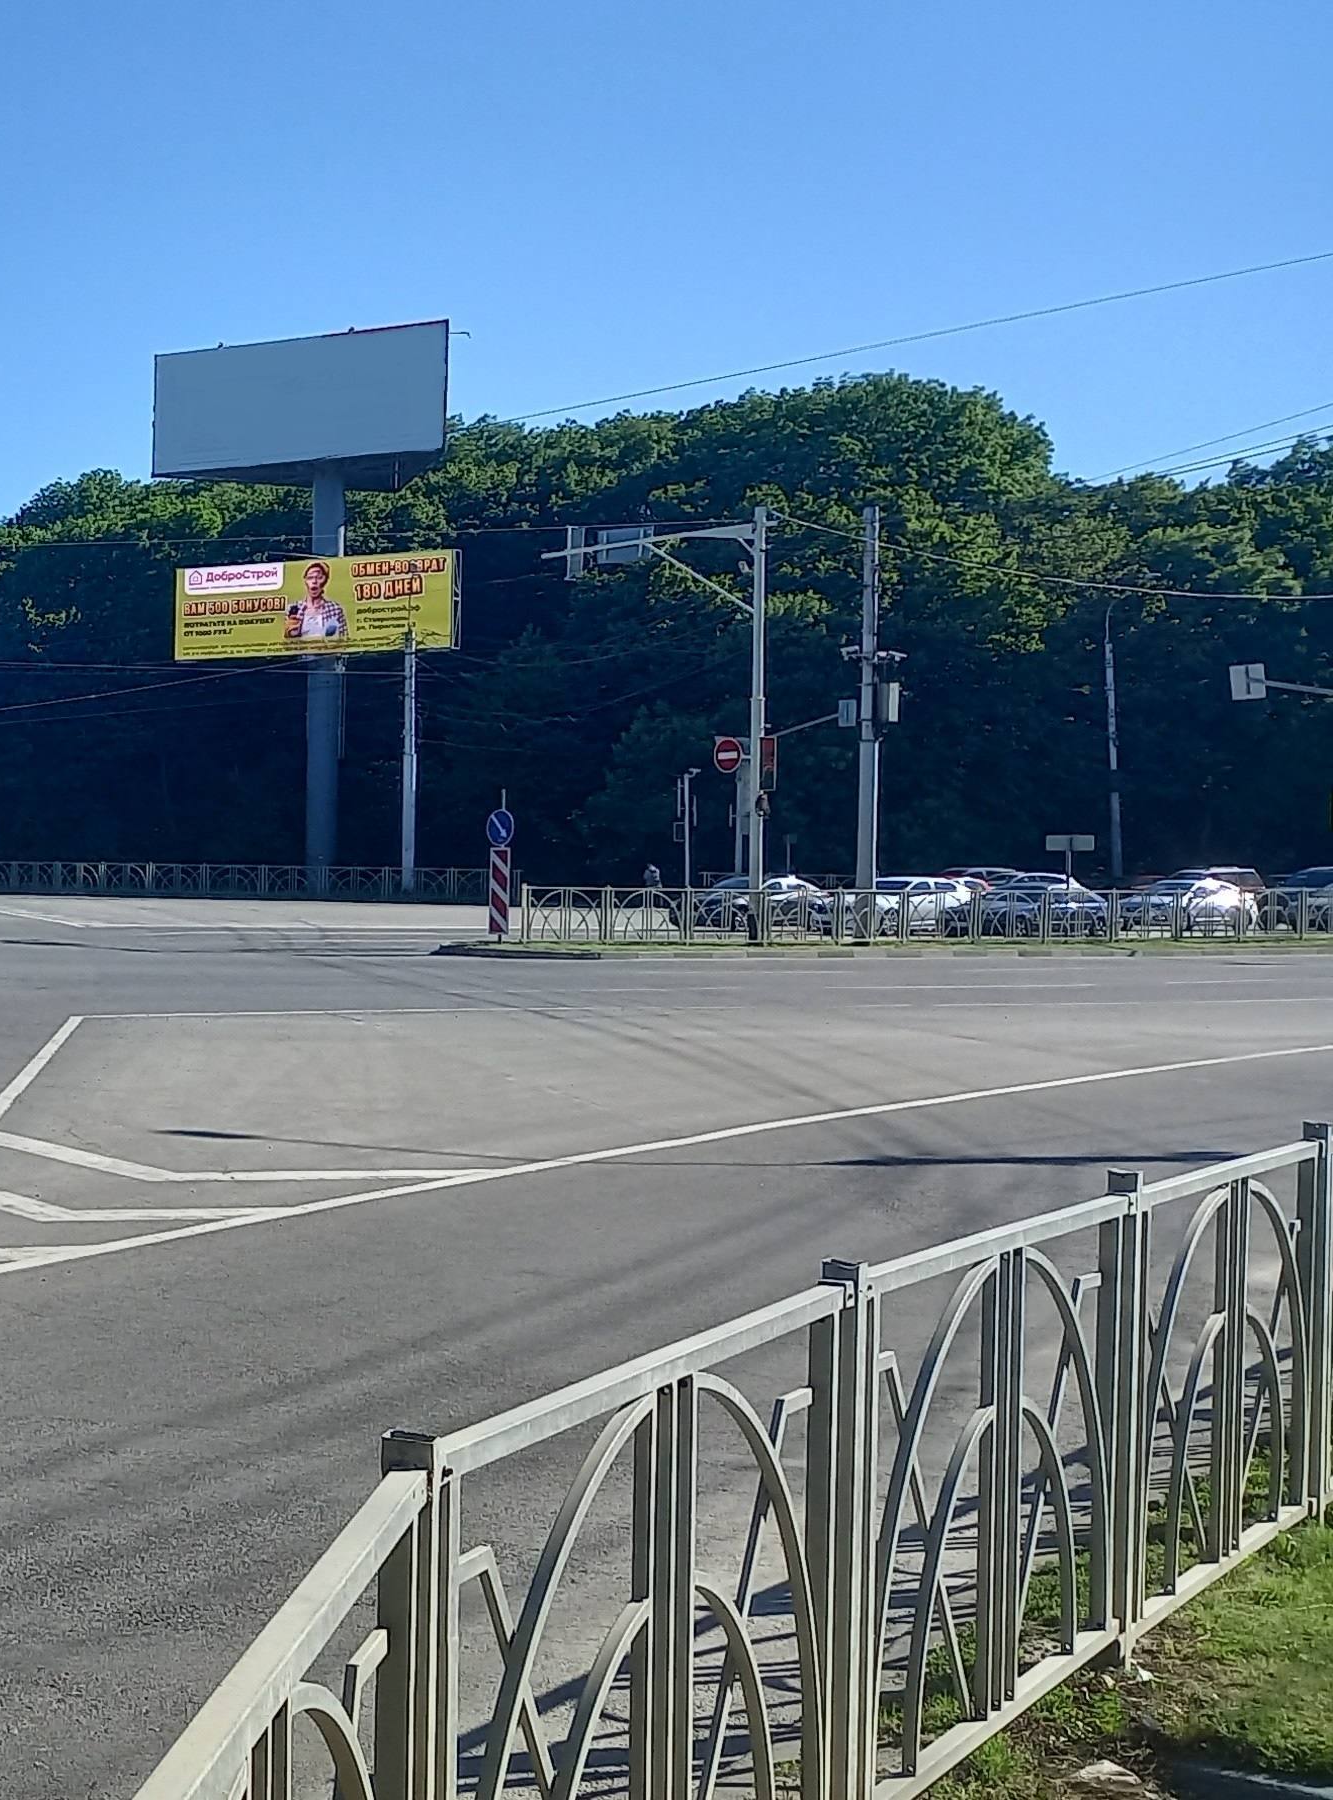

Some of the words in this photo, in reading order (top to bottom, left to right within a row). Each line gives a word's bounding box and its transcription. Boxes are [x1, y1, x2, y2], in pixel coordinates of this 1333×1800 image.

[205, 567, 278, 583] ДоброСтрой
[352, 557, 447, 577] ОБМЕН-ВОВРАТ
[355, 582, 381, 601] 180
[384, 574, 423, 600] ДНЕЙ
[183, 601, 207, 617] ВАМ
[207, 600, 229, 614] 500
